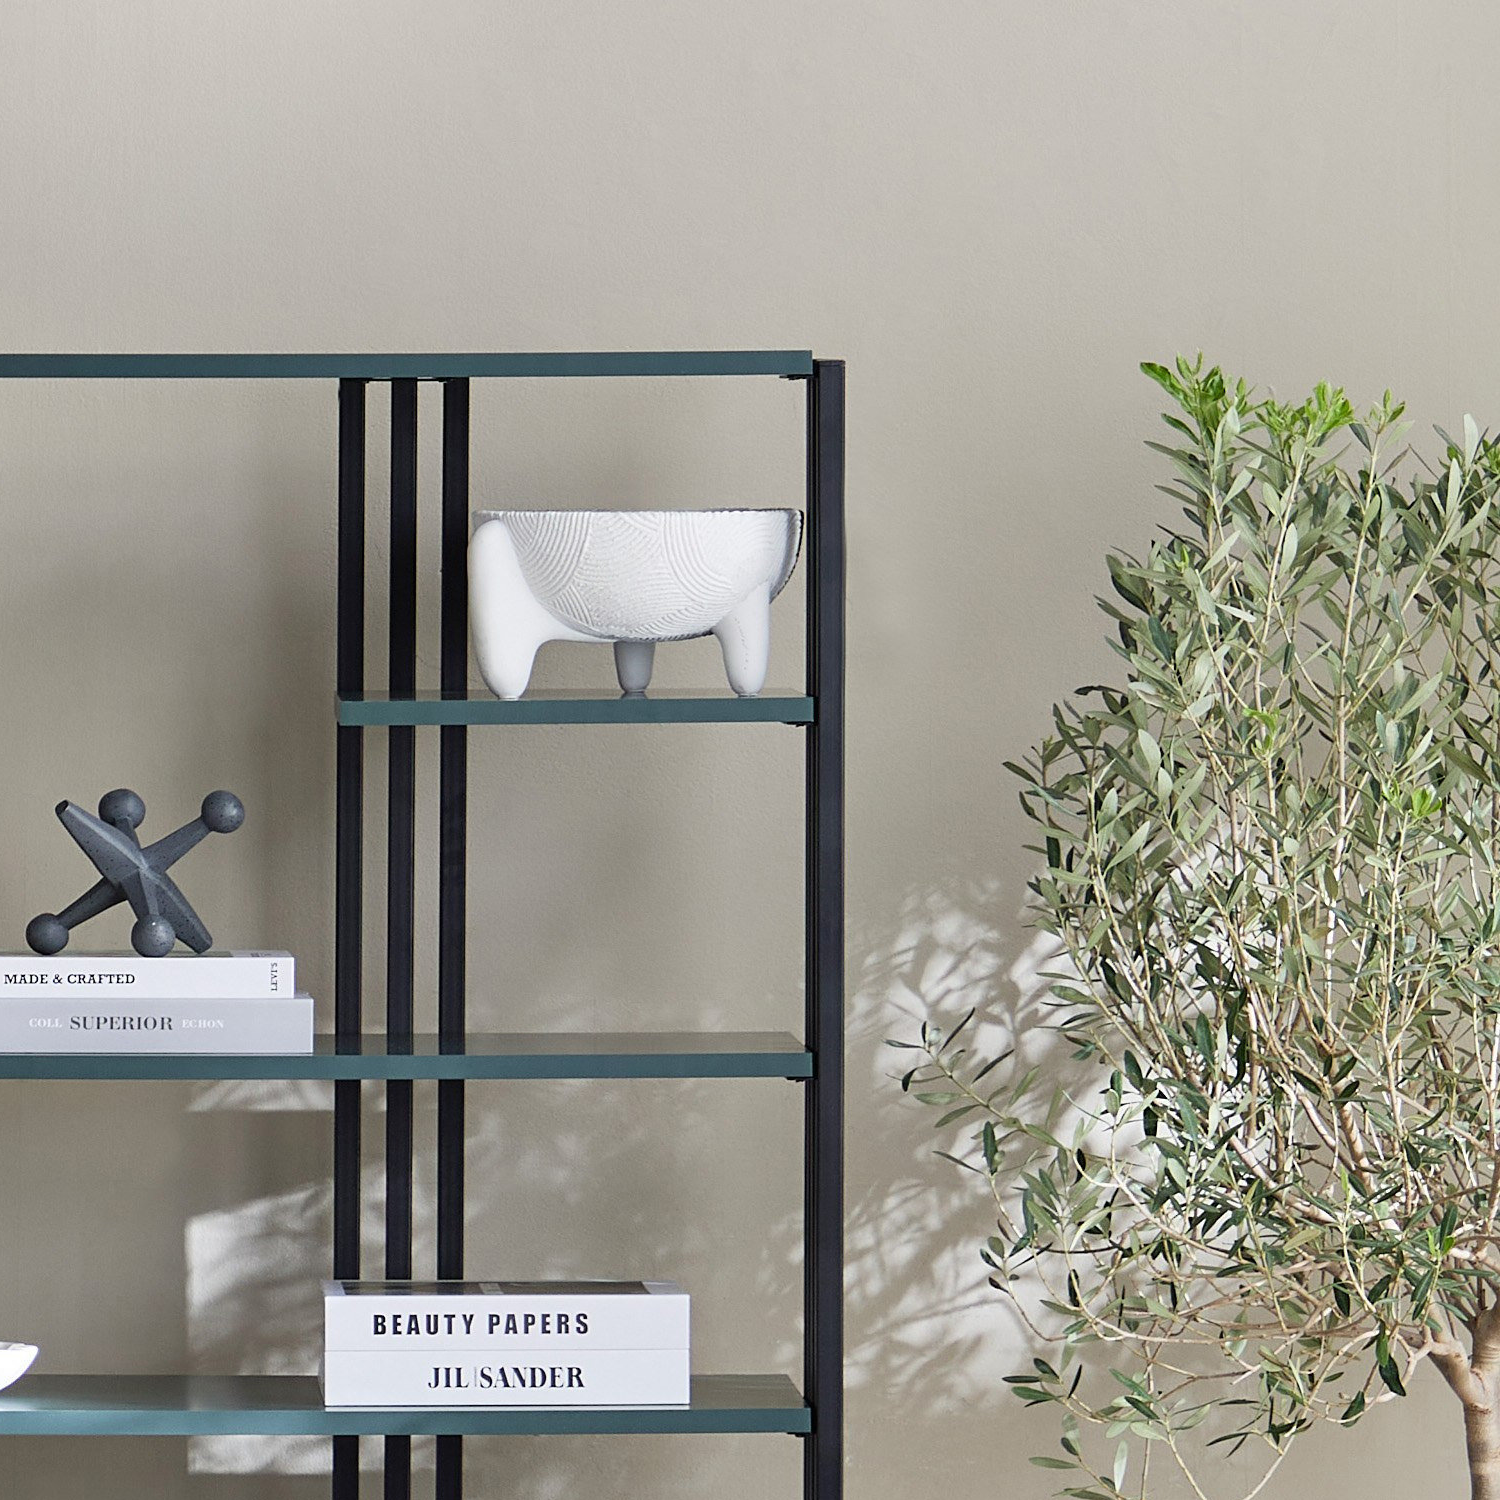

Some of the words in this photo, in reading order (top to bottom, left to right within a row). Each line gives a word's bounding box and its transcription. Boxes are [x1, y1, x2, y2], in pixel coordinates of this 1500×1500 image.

[4, 973, 49, 985] MADE
[52, 973, 63, 985] &
[67, 973, 136, 985] CRAFTED
[28, 1018, 63, 1029] COLL
[69, 1016, 174, 1031] SUPERIOR
[373, 1313, 475, 1335] BEAUTY
[488, 1312, 590, 1335] PAPERS
